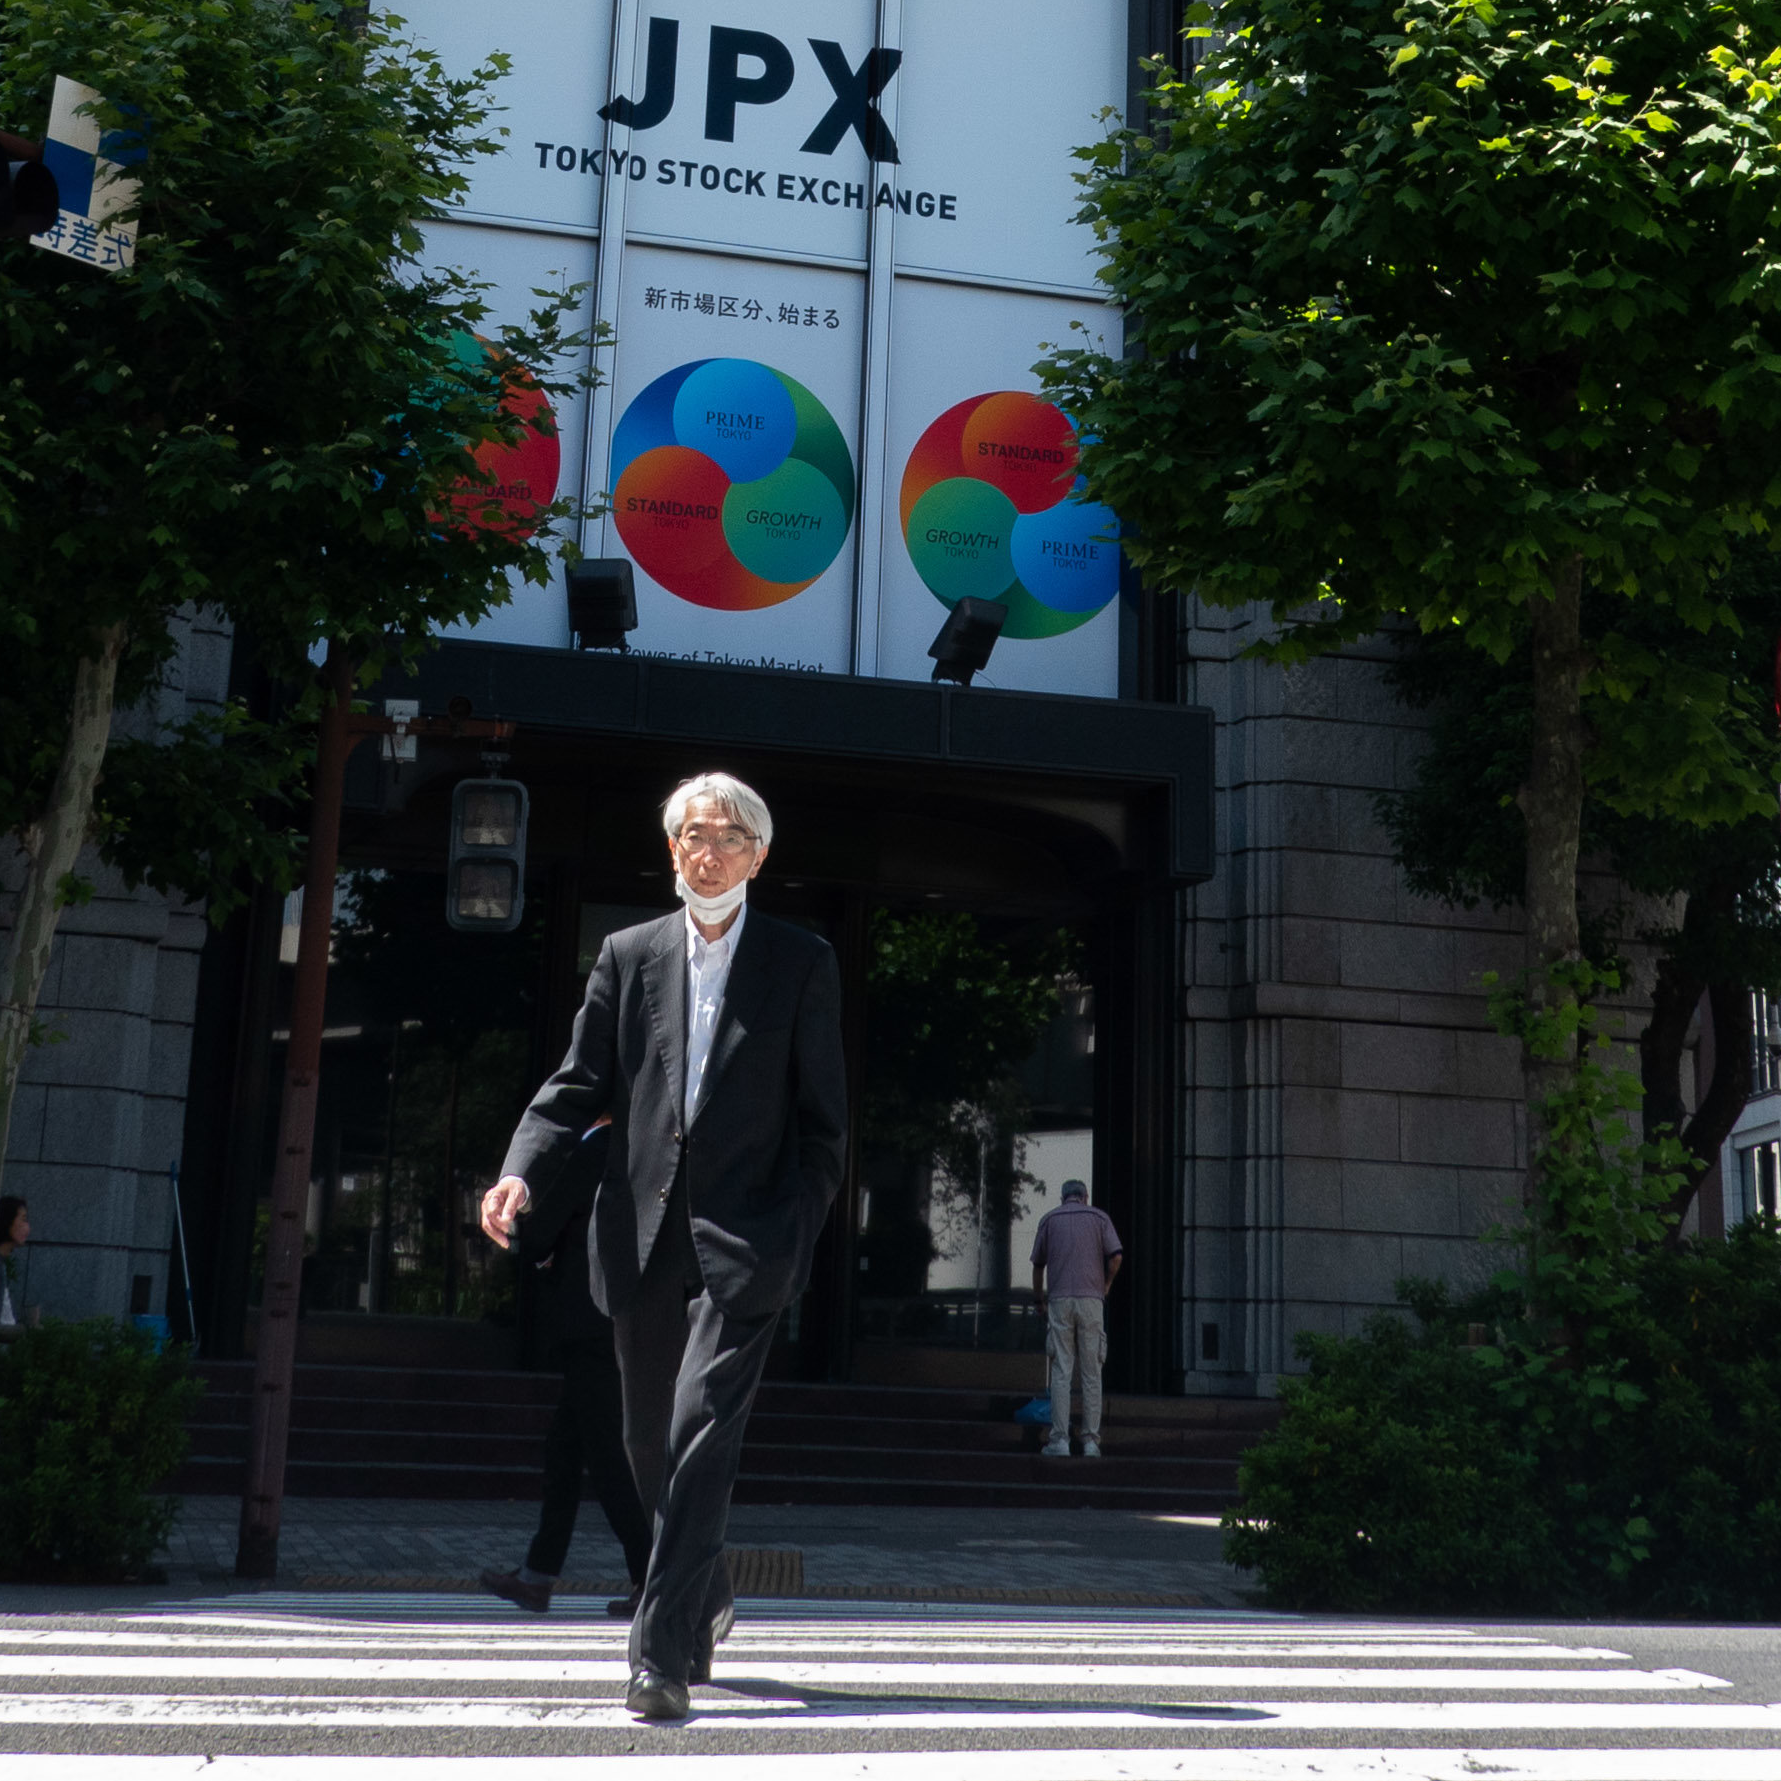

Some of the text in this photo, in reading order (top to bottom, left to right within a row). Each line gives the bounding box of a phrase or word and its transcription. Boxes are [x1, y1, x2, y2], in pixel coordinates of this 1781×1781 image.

[596, 16, 903, 165] JPX
[534, 141, 958, 221] TOKYO STOCK EXCHANGE
[644, 285, 840, 330] 新市場区分、始まる
[705, 410, 765, 430] PRIME
[716, 427, 752, 441] TOKYO
[977, 442, 1064, 464] STANDARD
[627, 497, 718, 520] STANDARD
[652, 516, 690, 531] TOKYO
[746, 509, 821, 530] GROWTH
[765, 527, 801, 541] TOKYO
[925, 528, 1000, 549] GROWTH
[944, 546, 979, 560] TOKYO
[1041, 539, 1101, 560] PRIME
[1052, 556, 1087, 570] TOKYO
